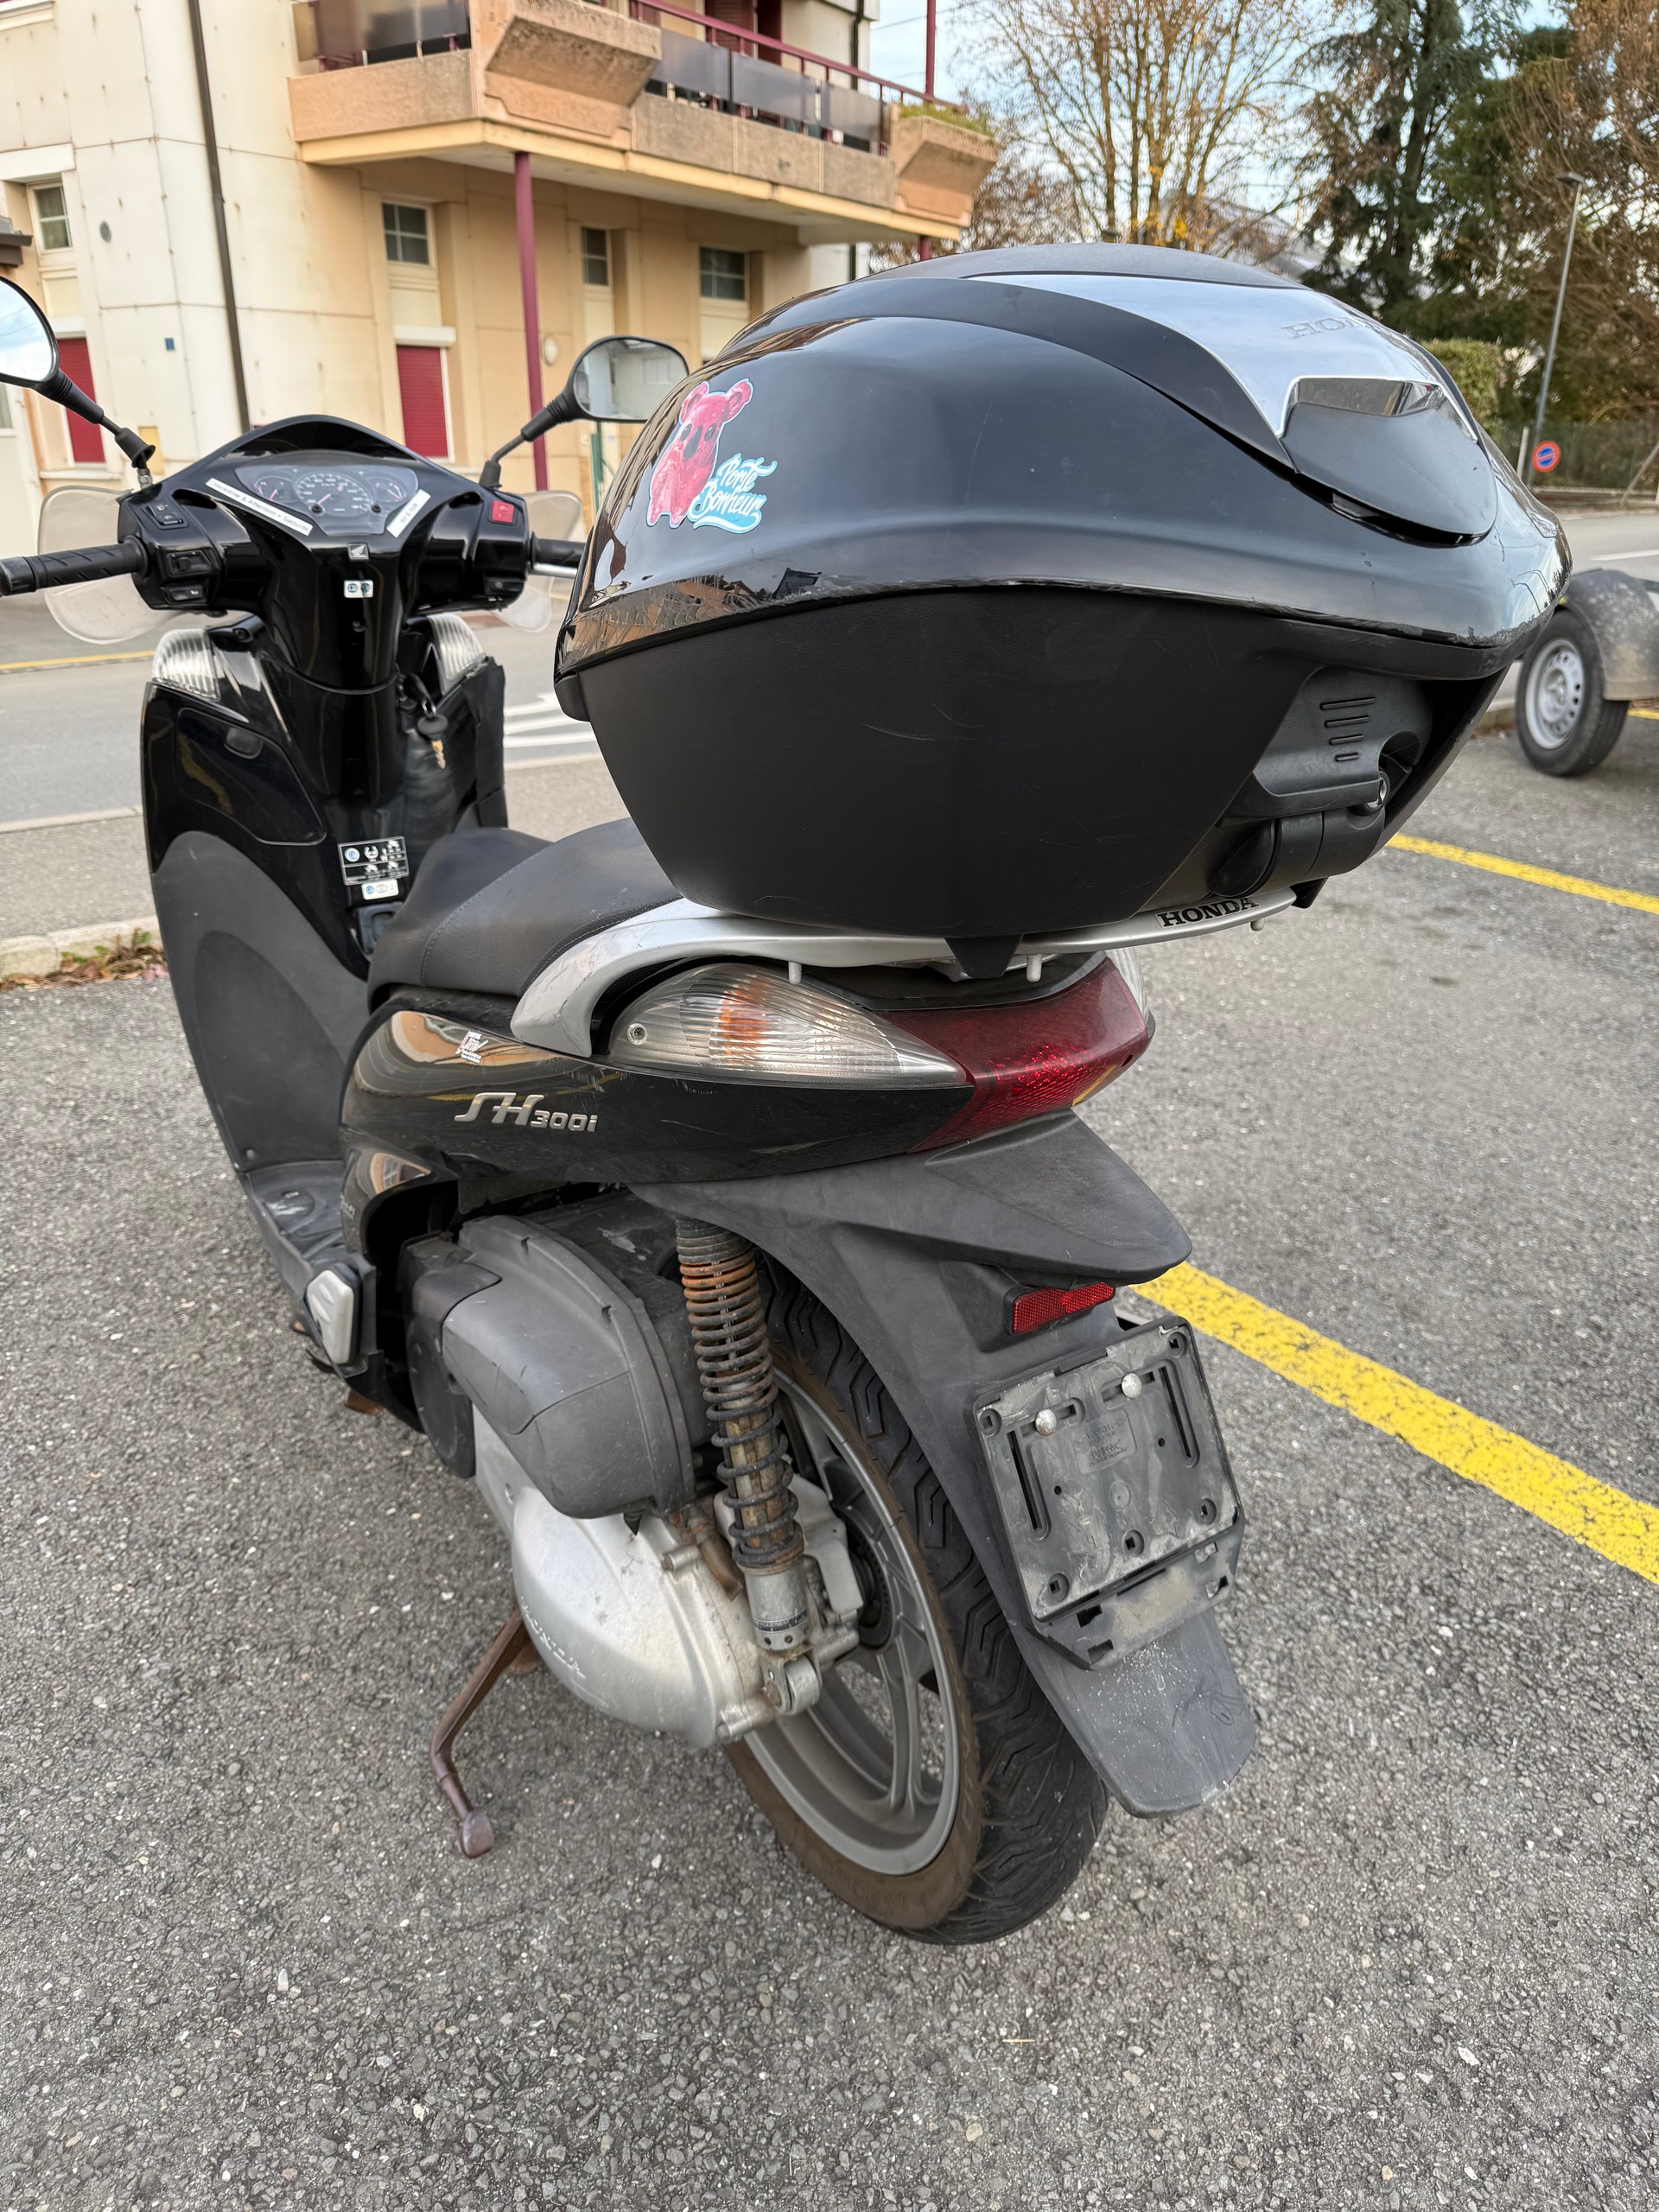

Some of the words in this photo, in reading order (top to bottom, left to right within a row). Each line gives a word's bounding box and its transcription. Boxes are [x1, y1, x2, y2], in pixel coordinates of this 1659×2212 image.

[718, 454, 777, 489] Porte
[691, 481, 766, 521] Bonheur
[1157, 898, 1260, 927] HONDA
